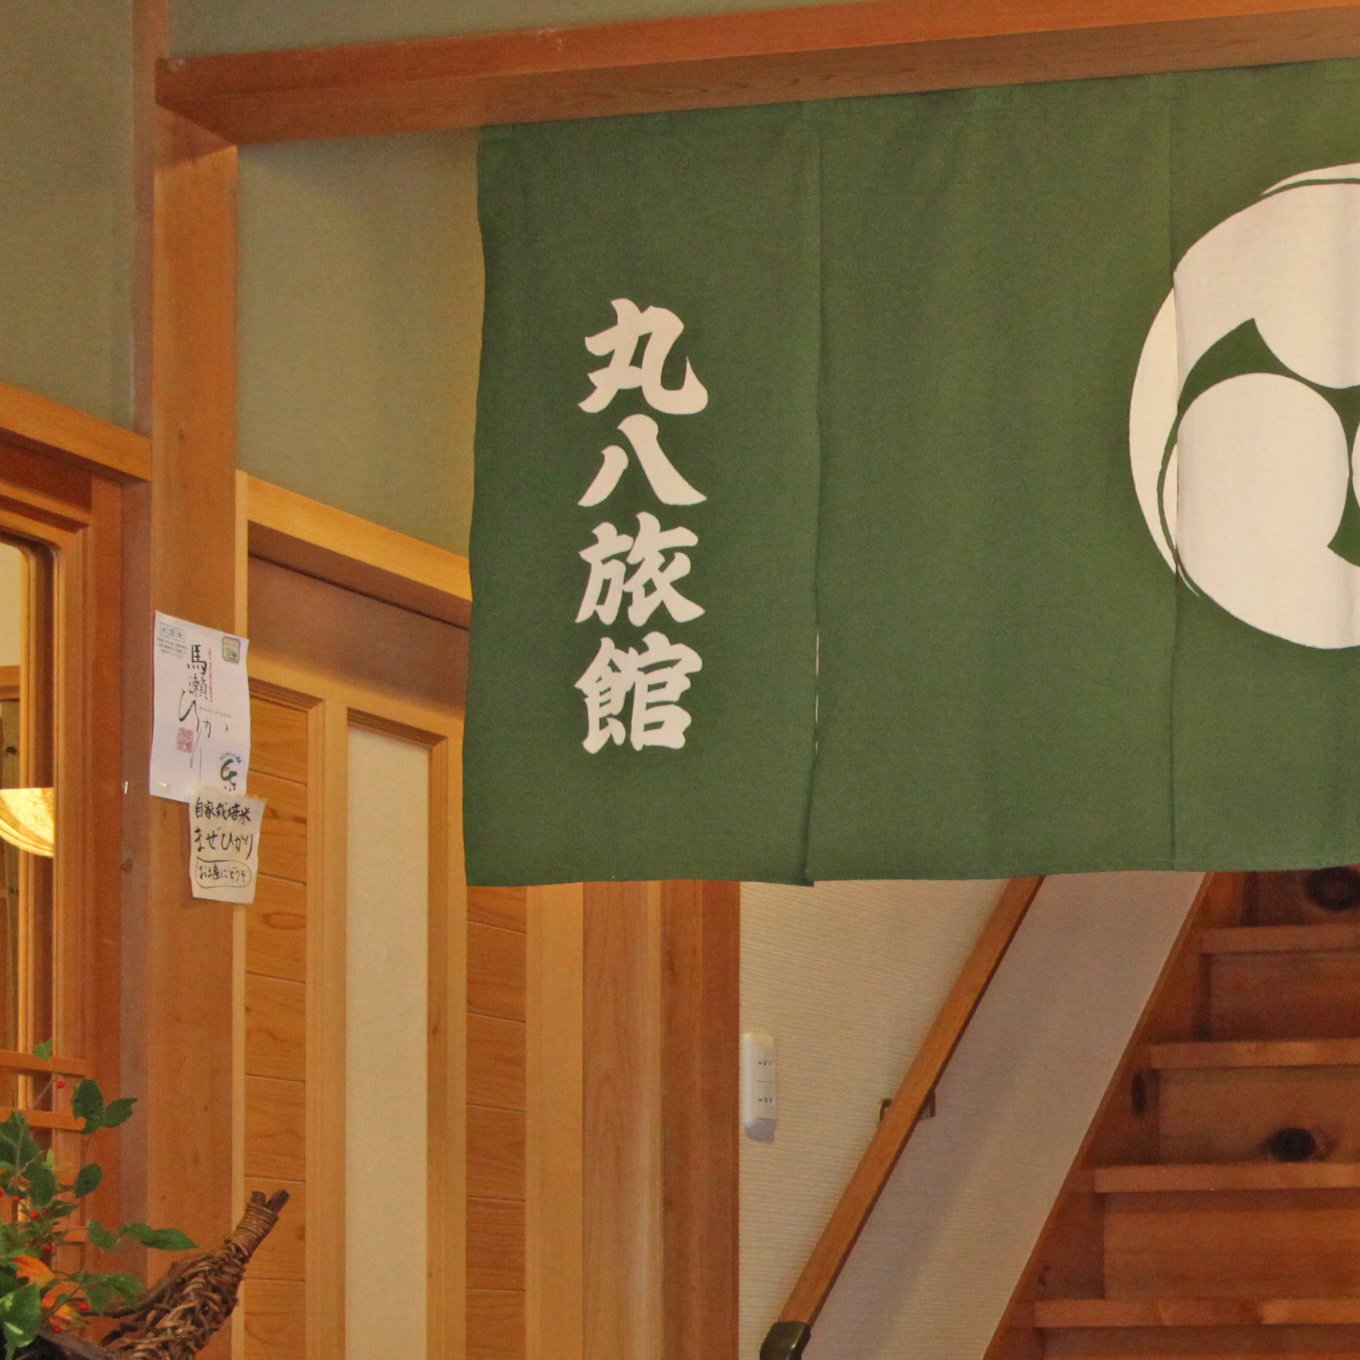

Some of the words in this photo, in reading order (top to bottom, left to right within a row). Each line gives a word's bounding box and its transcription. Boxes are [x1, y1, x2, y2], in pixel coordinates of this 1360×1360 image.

[575, 298, 709, 754] 丸八旅館
[195, 797, 251, 825] 自家栽培米
[194, 826, 254, 860] まぜひかり
